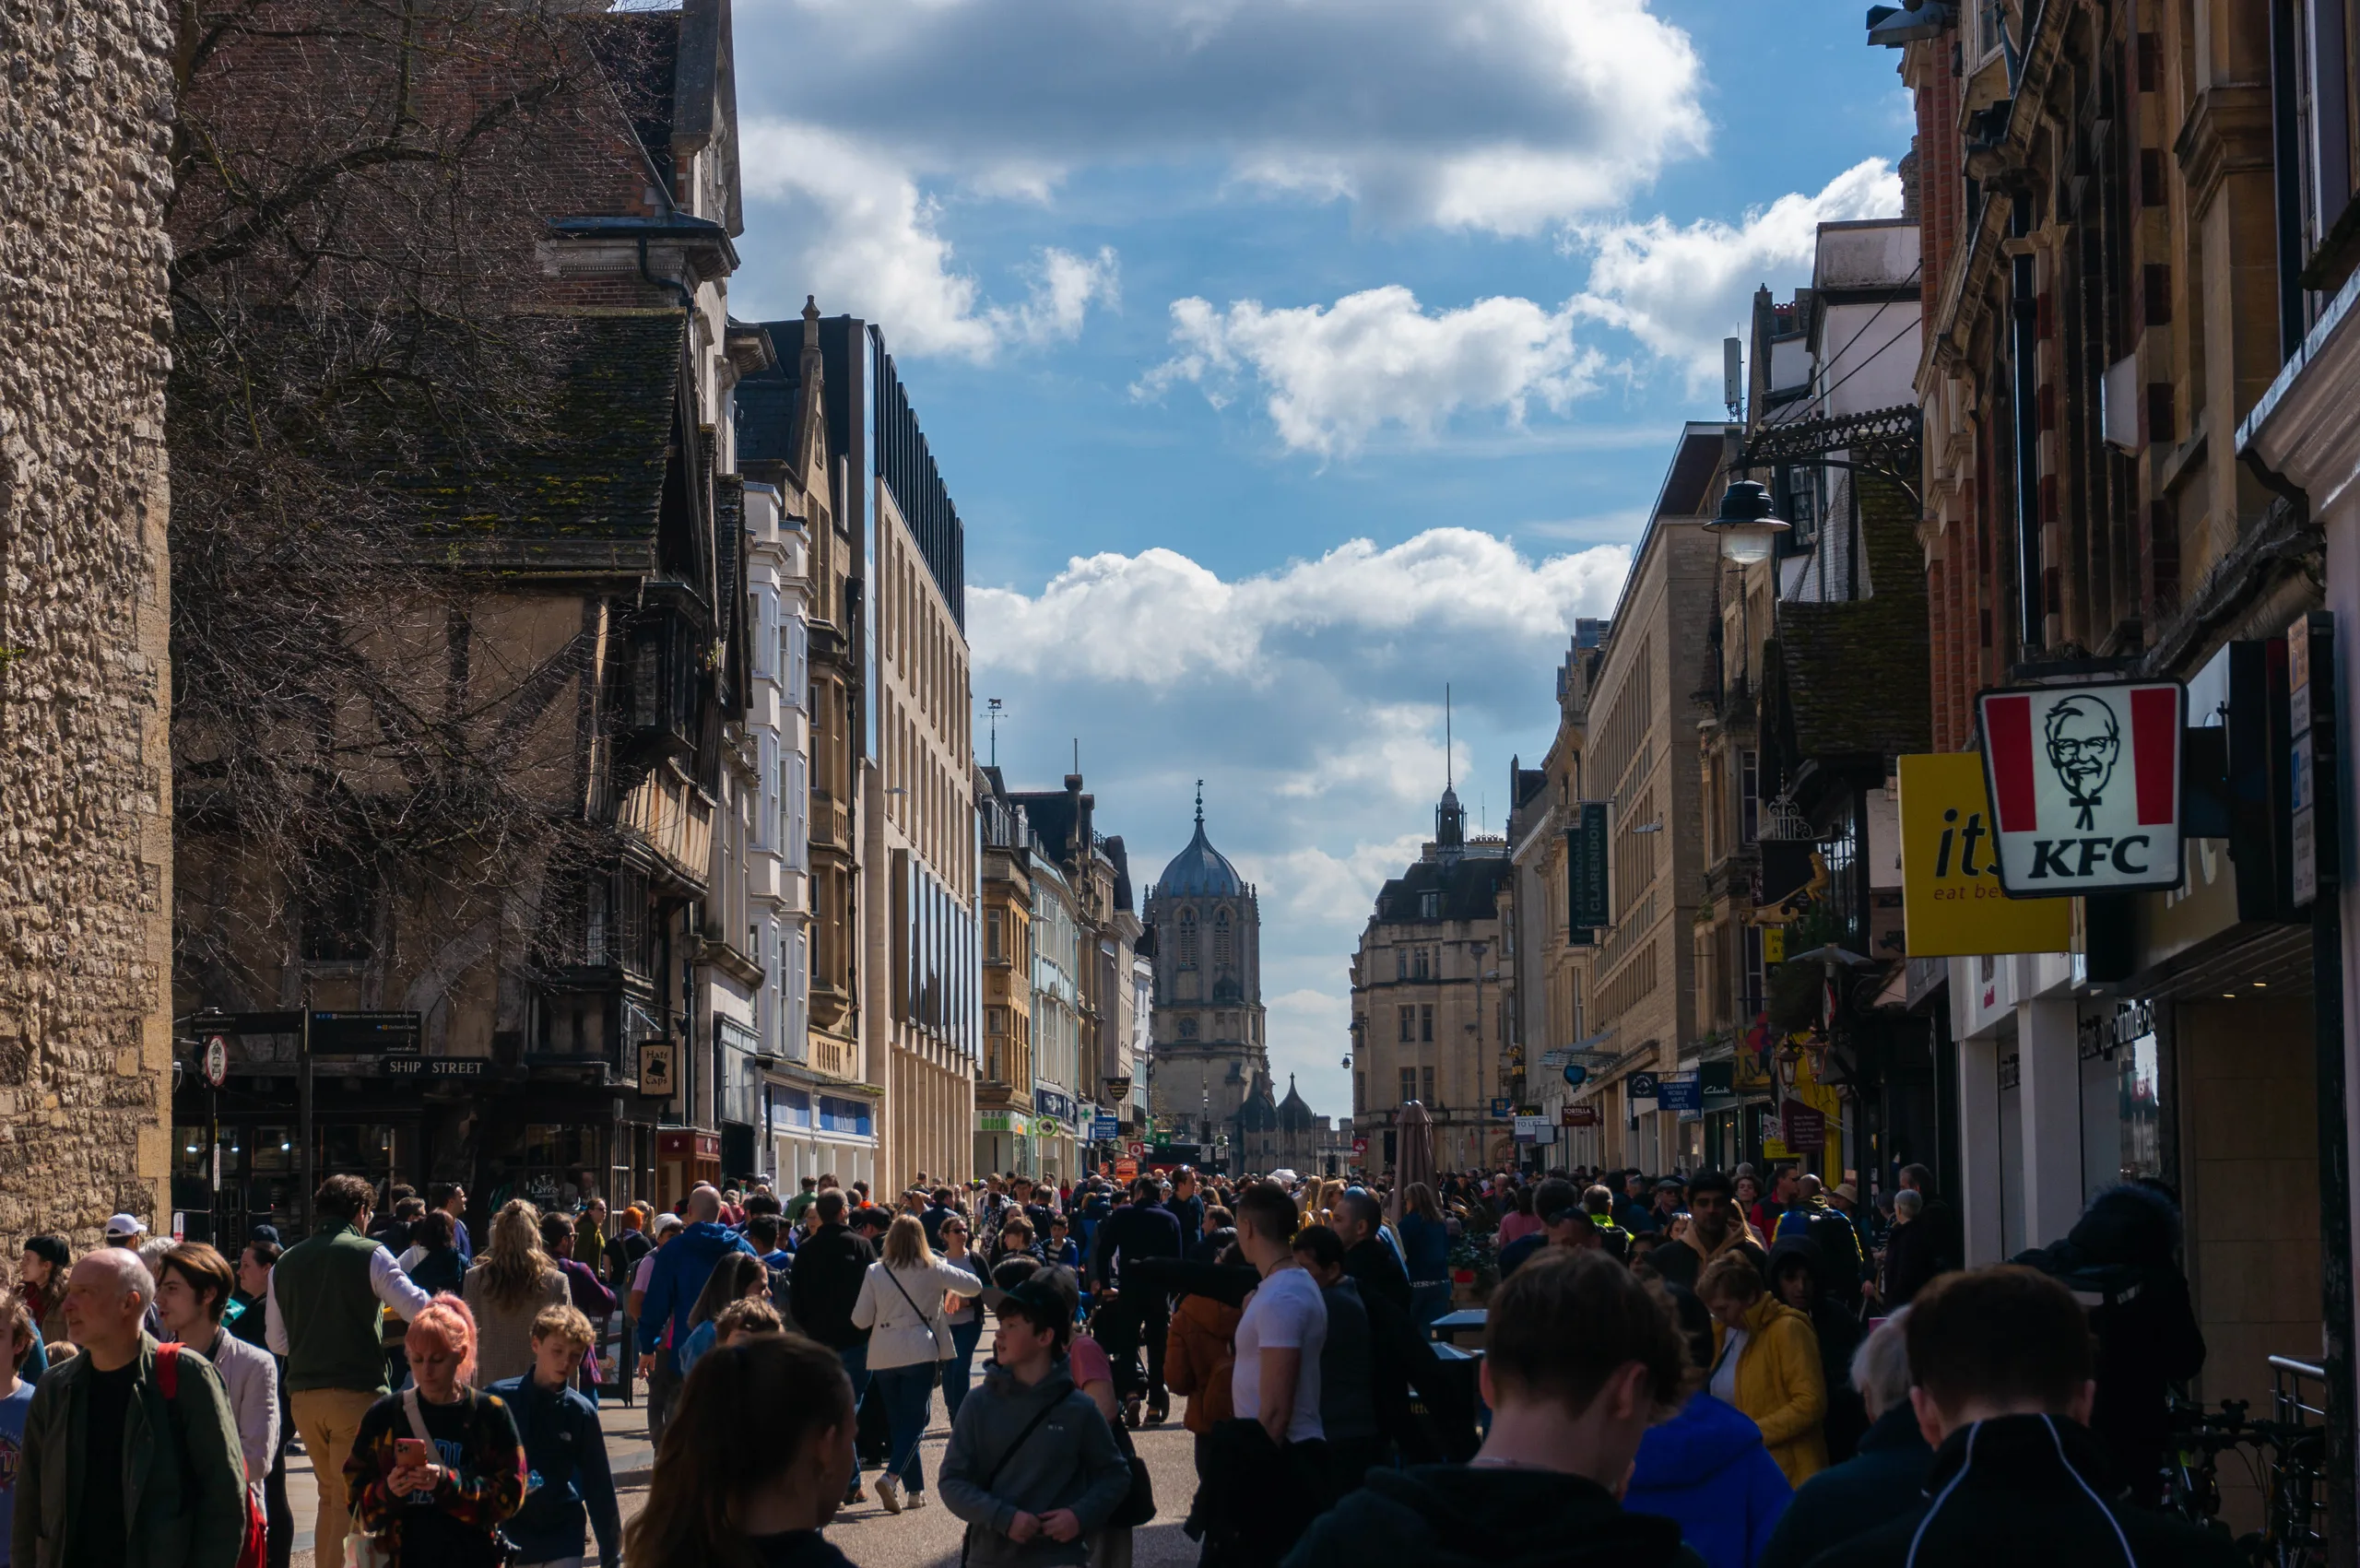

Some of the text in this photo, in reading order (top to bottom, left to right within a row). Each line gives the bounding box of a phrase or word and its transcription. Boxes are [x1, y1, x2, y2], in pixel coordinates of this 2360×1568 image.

[2027, 834, 2151, 879] KFC
[1588, 817, 1601, 913] CLARENDON
[1933, 887, 1966, 901] eat
[646, 1050, 668, 1059] Hats
[389, 1061, 484, 1074] SHIP STREET
[645, 1075, 668, 1088] Caps
[1704, 1085, 1731, 1095] Clarks
